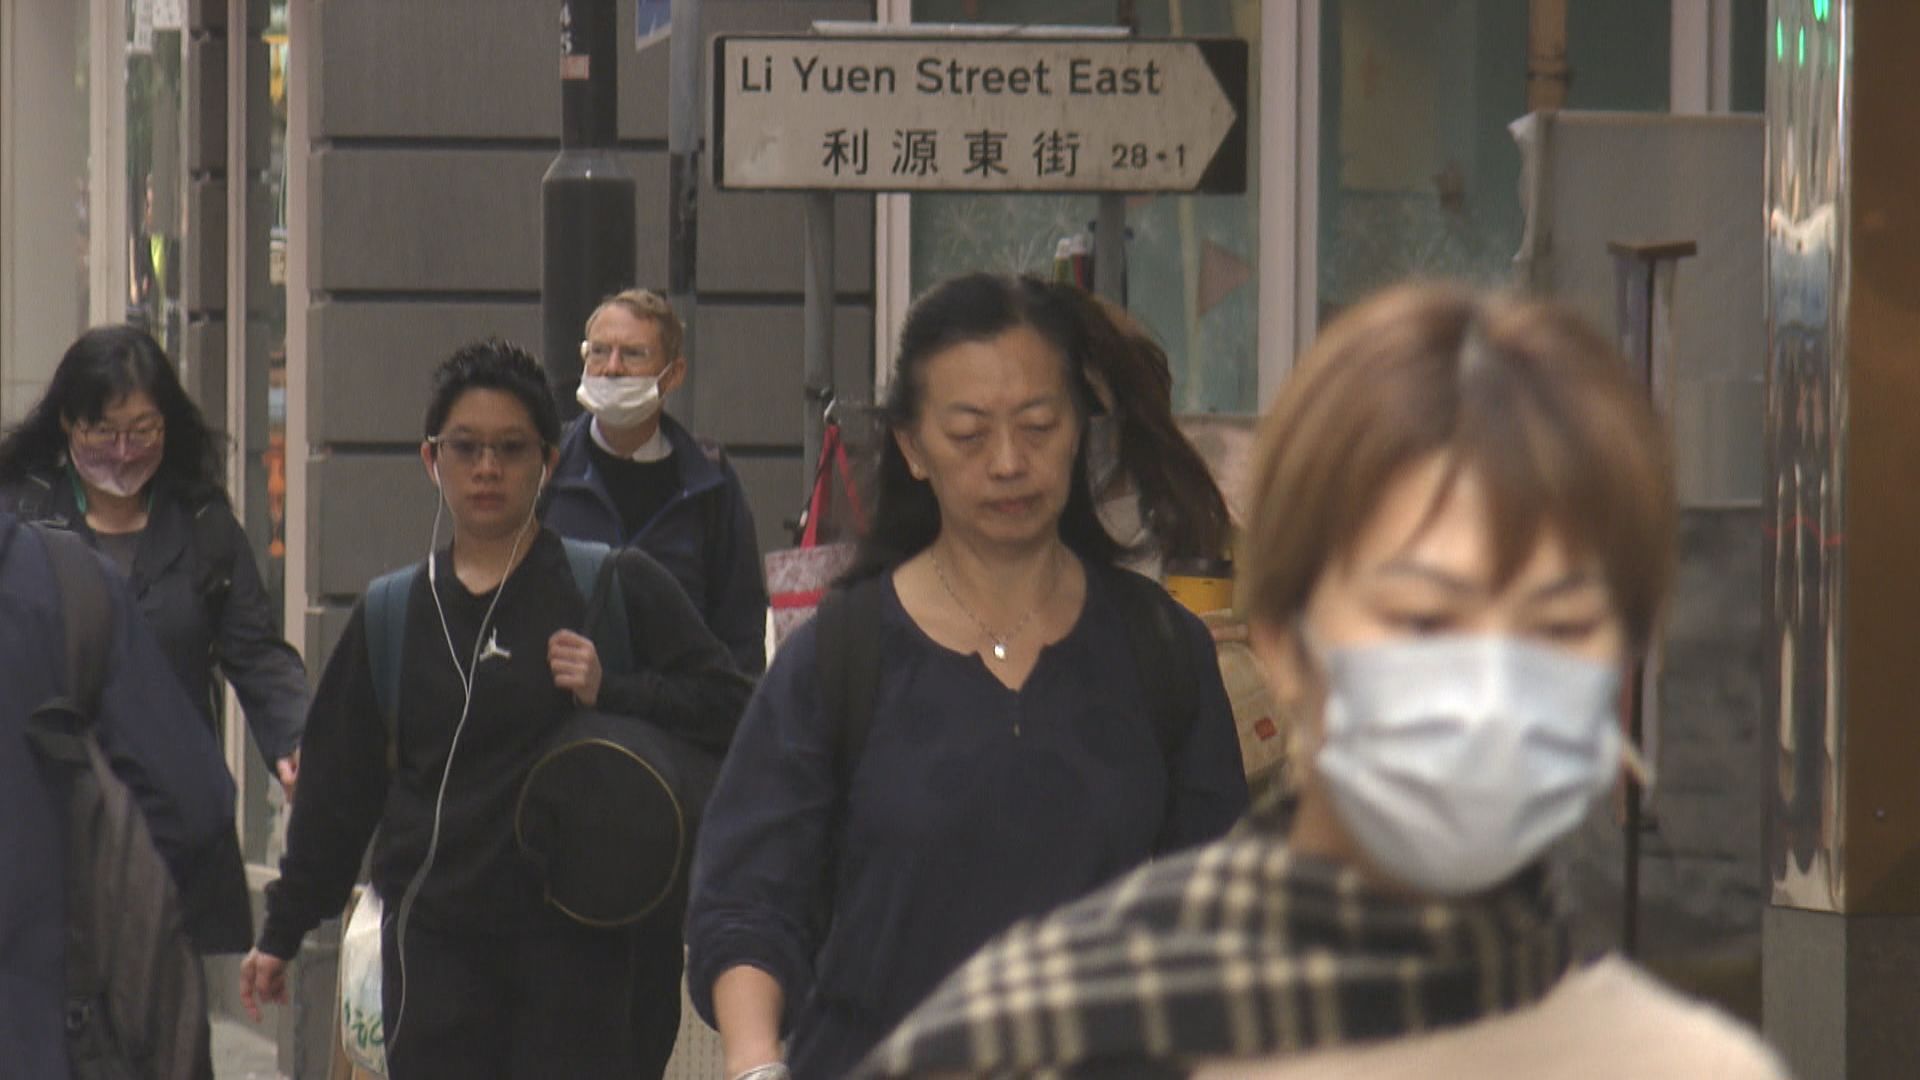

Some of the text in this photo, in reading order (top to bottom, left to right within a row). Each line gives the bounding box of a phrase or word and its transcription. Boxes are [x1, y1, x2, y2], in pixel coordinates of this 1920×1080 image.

[742, 57, 1161, 95] Li Yuen Street East
[822, 128, 1080, 178] 利源東街
